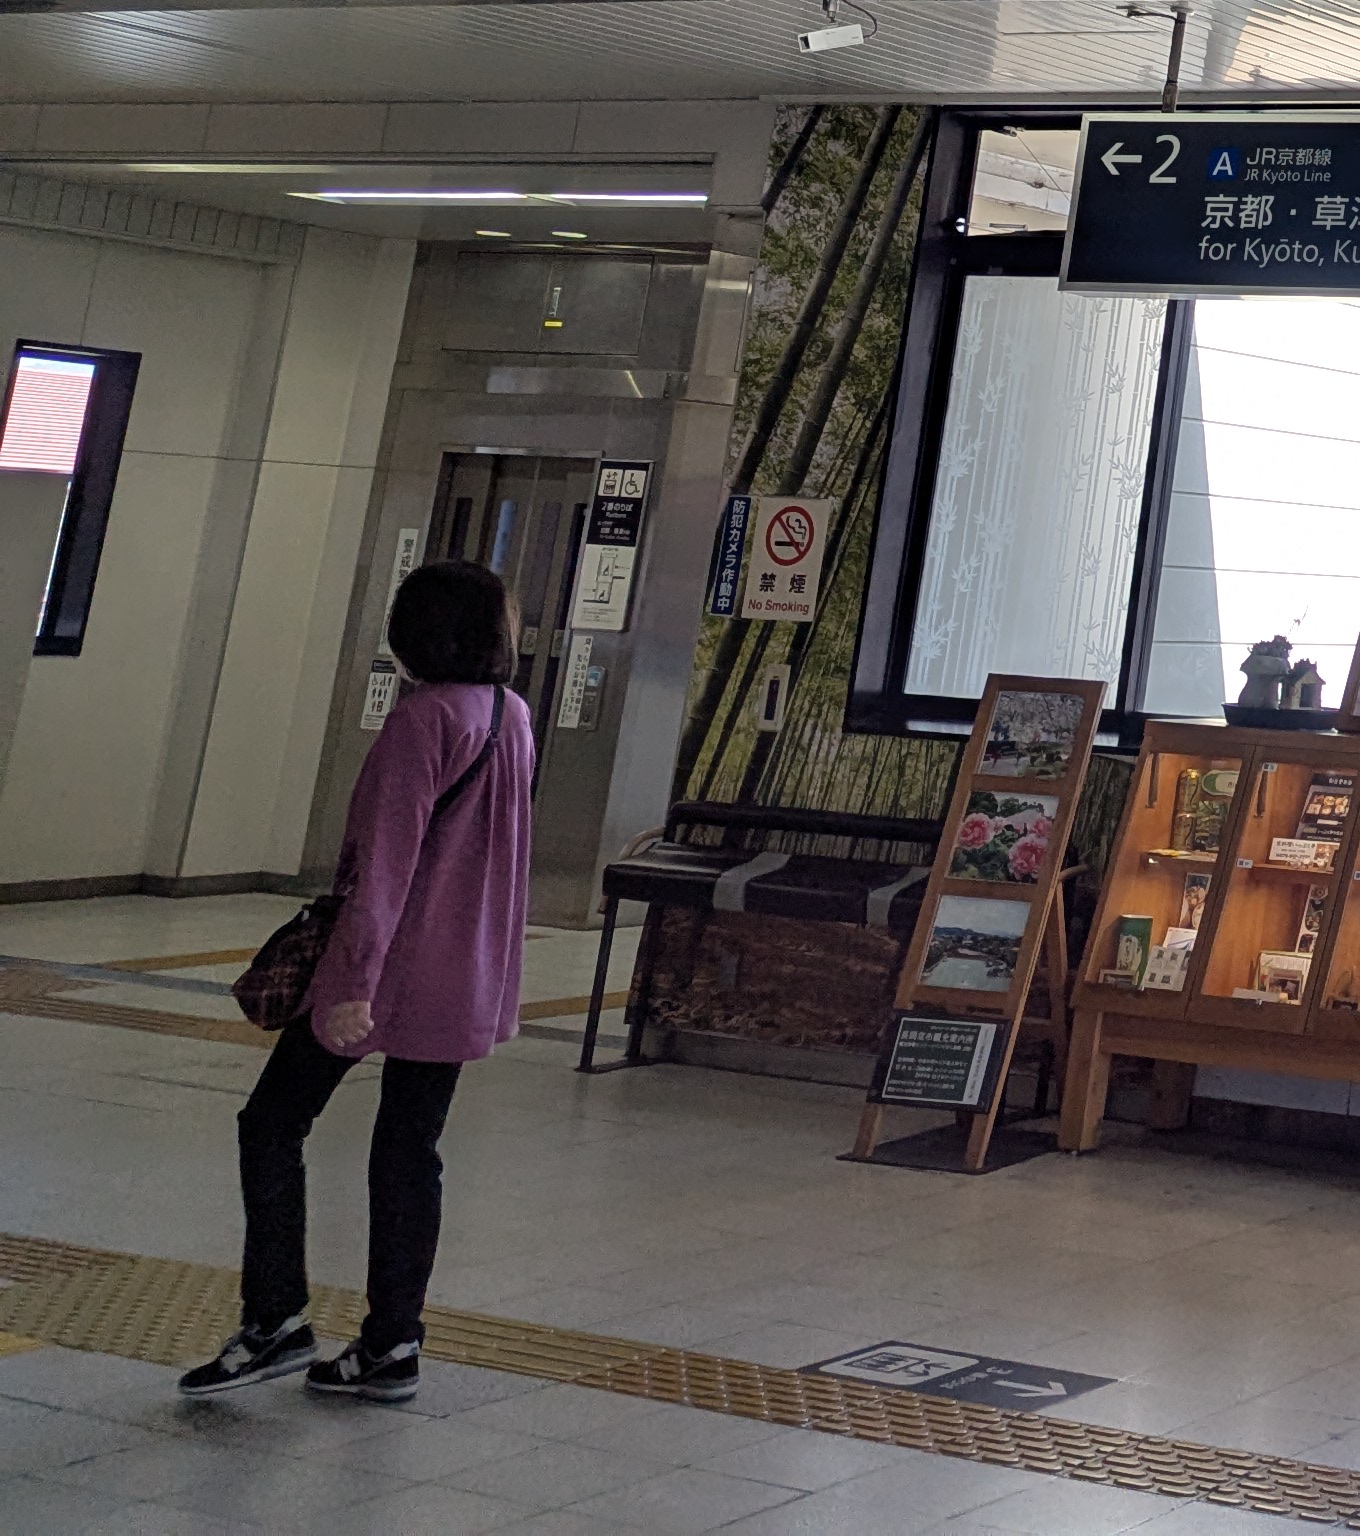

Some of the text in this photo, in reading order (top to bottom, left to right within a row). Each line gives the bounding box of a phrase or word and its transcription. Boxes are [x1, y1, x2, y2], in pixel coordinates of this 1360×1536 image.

[1149, 134, 1181, 184] 2
[1212, 151, 1233, 177] A
[1245, 147, 1332, 166] JR京都線
[1244, 168, 1332, 184] JR Kyōto Line
[1198, 236, 1237, 262] for
[1244, 237, 1324, 268] Kyōto,
[717, 500, 746, 611] 防犯カメラ作動中
[748, 599, 809, 615] No Smoking
